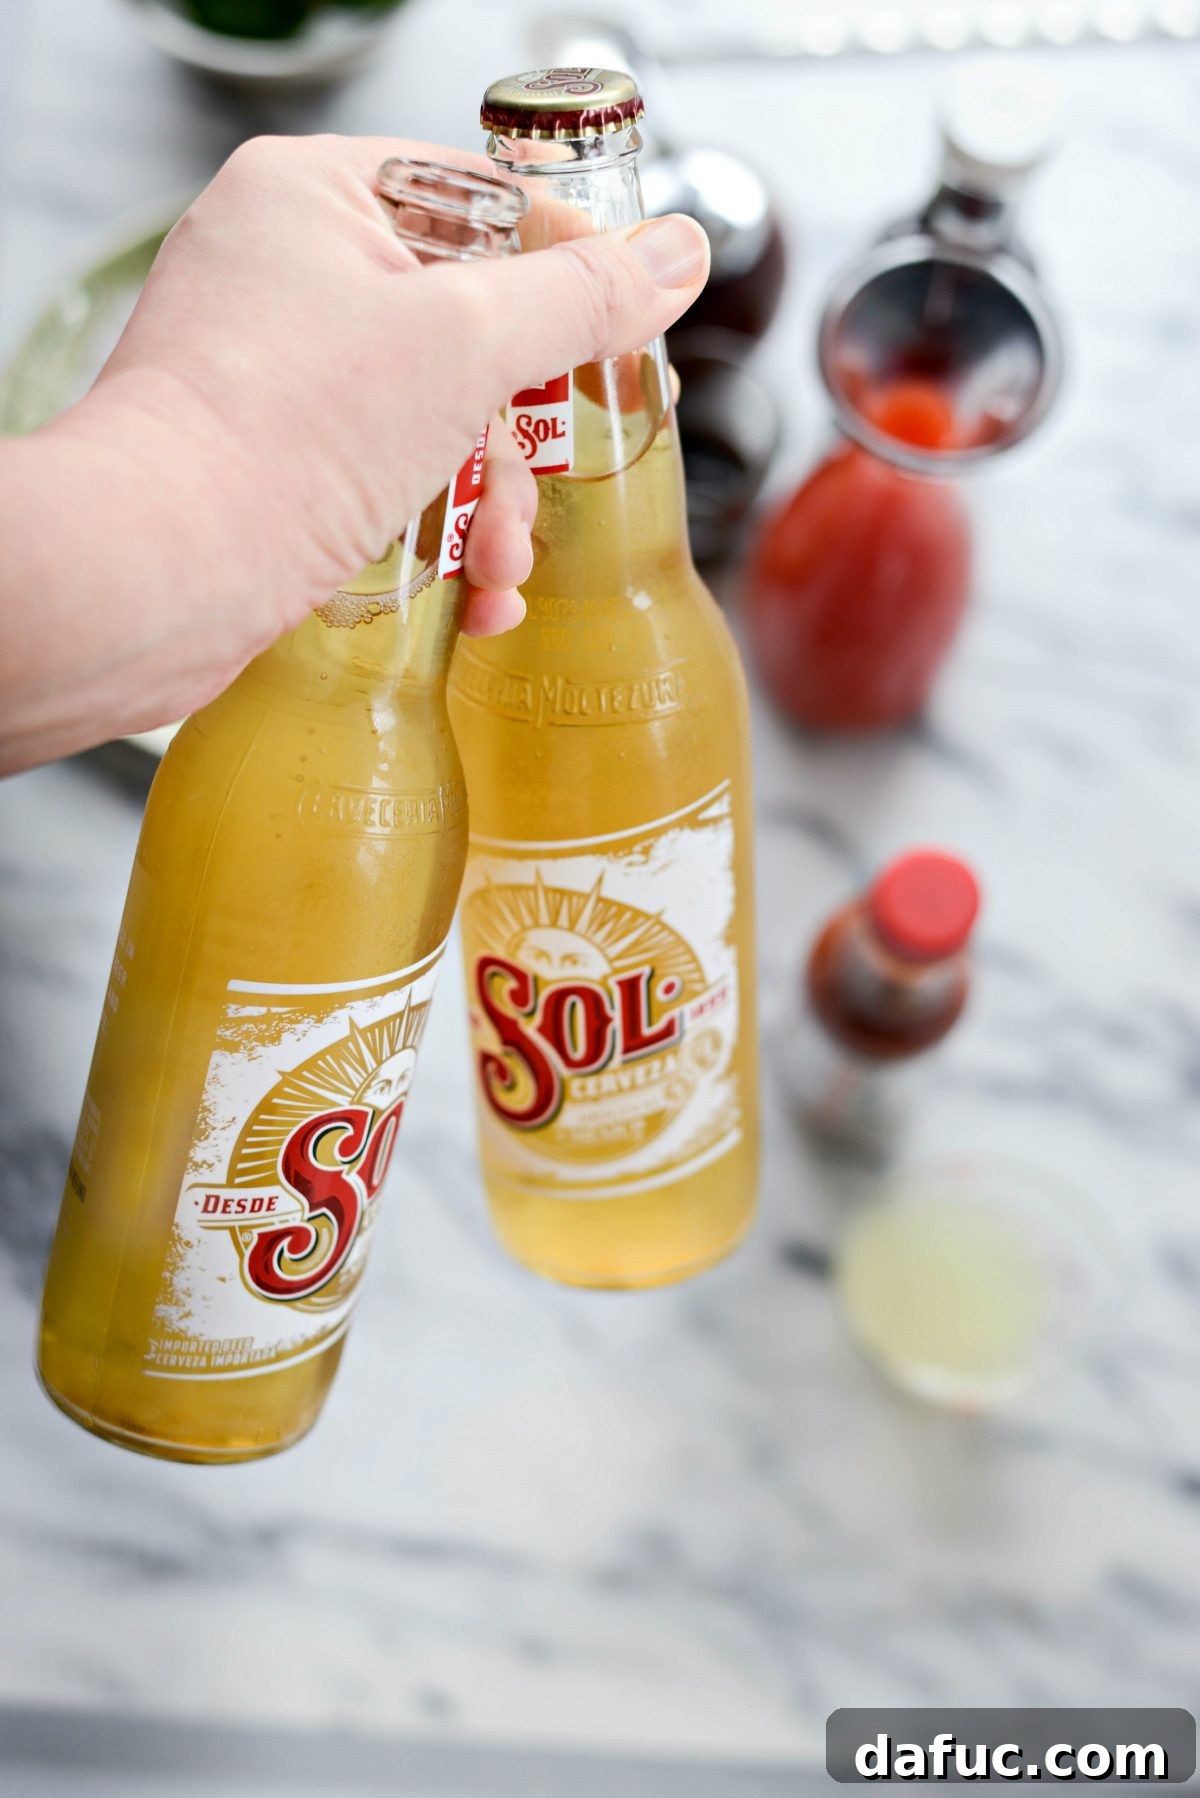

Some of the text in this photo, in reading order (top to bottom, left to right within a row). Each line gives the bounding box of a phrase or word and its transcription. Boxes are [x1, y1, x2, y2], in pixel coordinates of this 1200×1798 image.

[570, 1053, 678, 1098] CERVEZA
[200, 1193, 279, 1215] DESDE
[155, 1352, 207, 1368] CERVEZA
